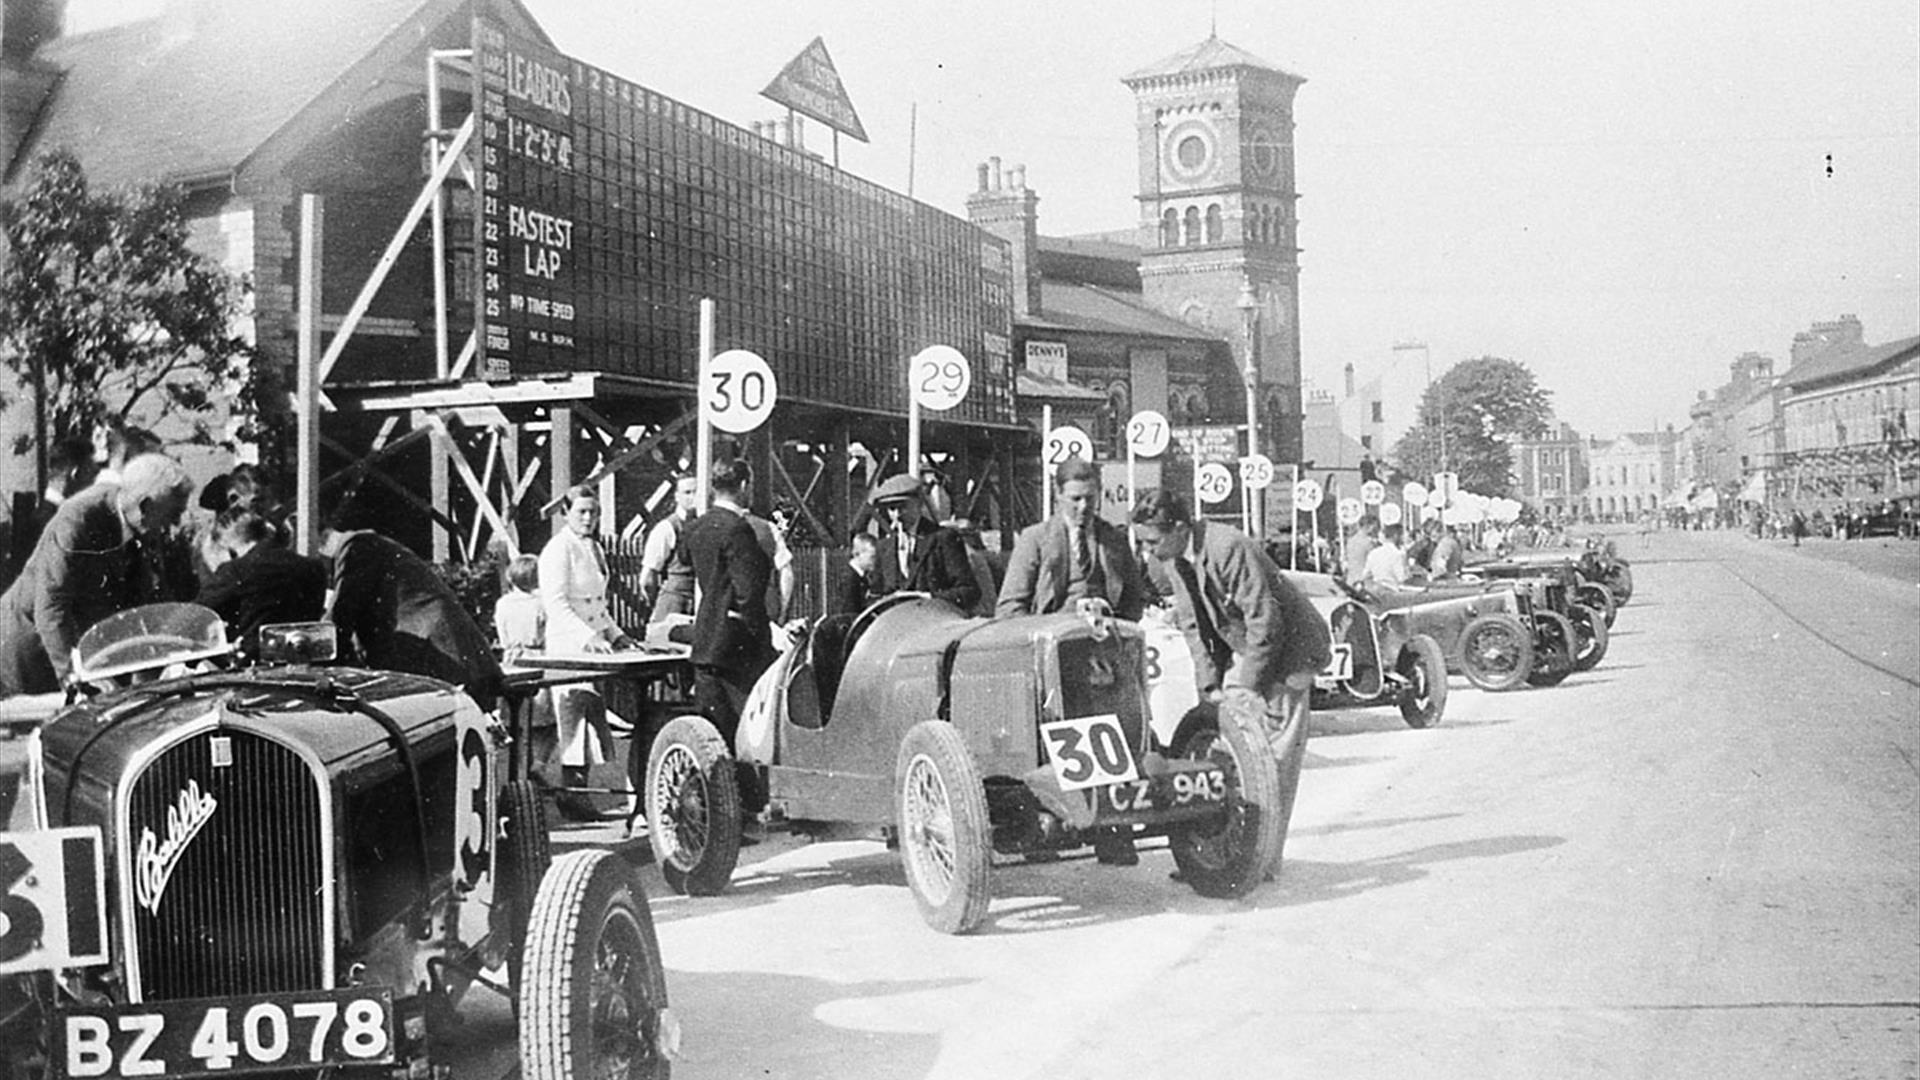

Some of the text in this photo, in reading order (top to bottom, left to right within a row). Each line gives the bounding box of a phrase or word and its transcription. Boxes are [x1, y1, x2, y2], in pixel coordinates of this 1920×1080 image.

[507, 52, 571, 116] LEADERS
[485, 145, 497, 165] 15
[485, 172, 498, 190] 20
[485, 196, 497, 215] 21
[485, 222, 498, 242] 22
[509, 204, 573, 250] FASTEST
[486, 247, 498, 266] 23
[525, 244, 560, 280] LAP
[486, 272, 499, 292] 24
[486, 298, 499, 316] 25
[527, 296, 550, 317] TIME
[551, 301, 574, 321] SPEED
[921, 362, 963, 393] 29
[710, 371, 765, 412] 30
[1132, 422, 1161, 445] 27
[1050, 440, 1082, 464] 28
[1200, 472, 1227, 494] 26
[1246, 463, 1268, 481] 25
[1298, 487, 1317, 503] 24
[1049, 722, 1129, 783] 30
[1108, 770, 1226, 811] CZ 943
[65, 999, 388, 1076] BZ 4078
